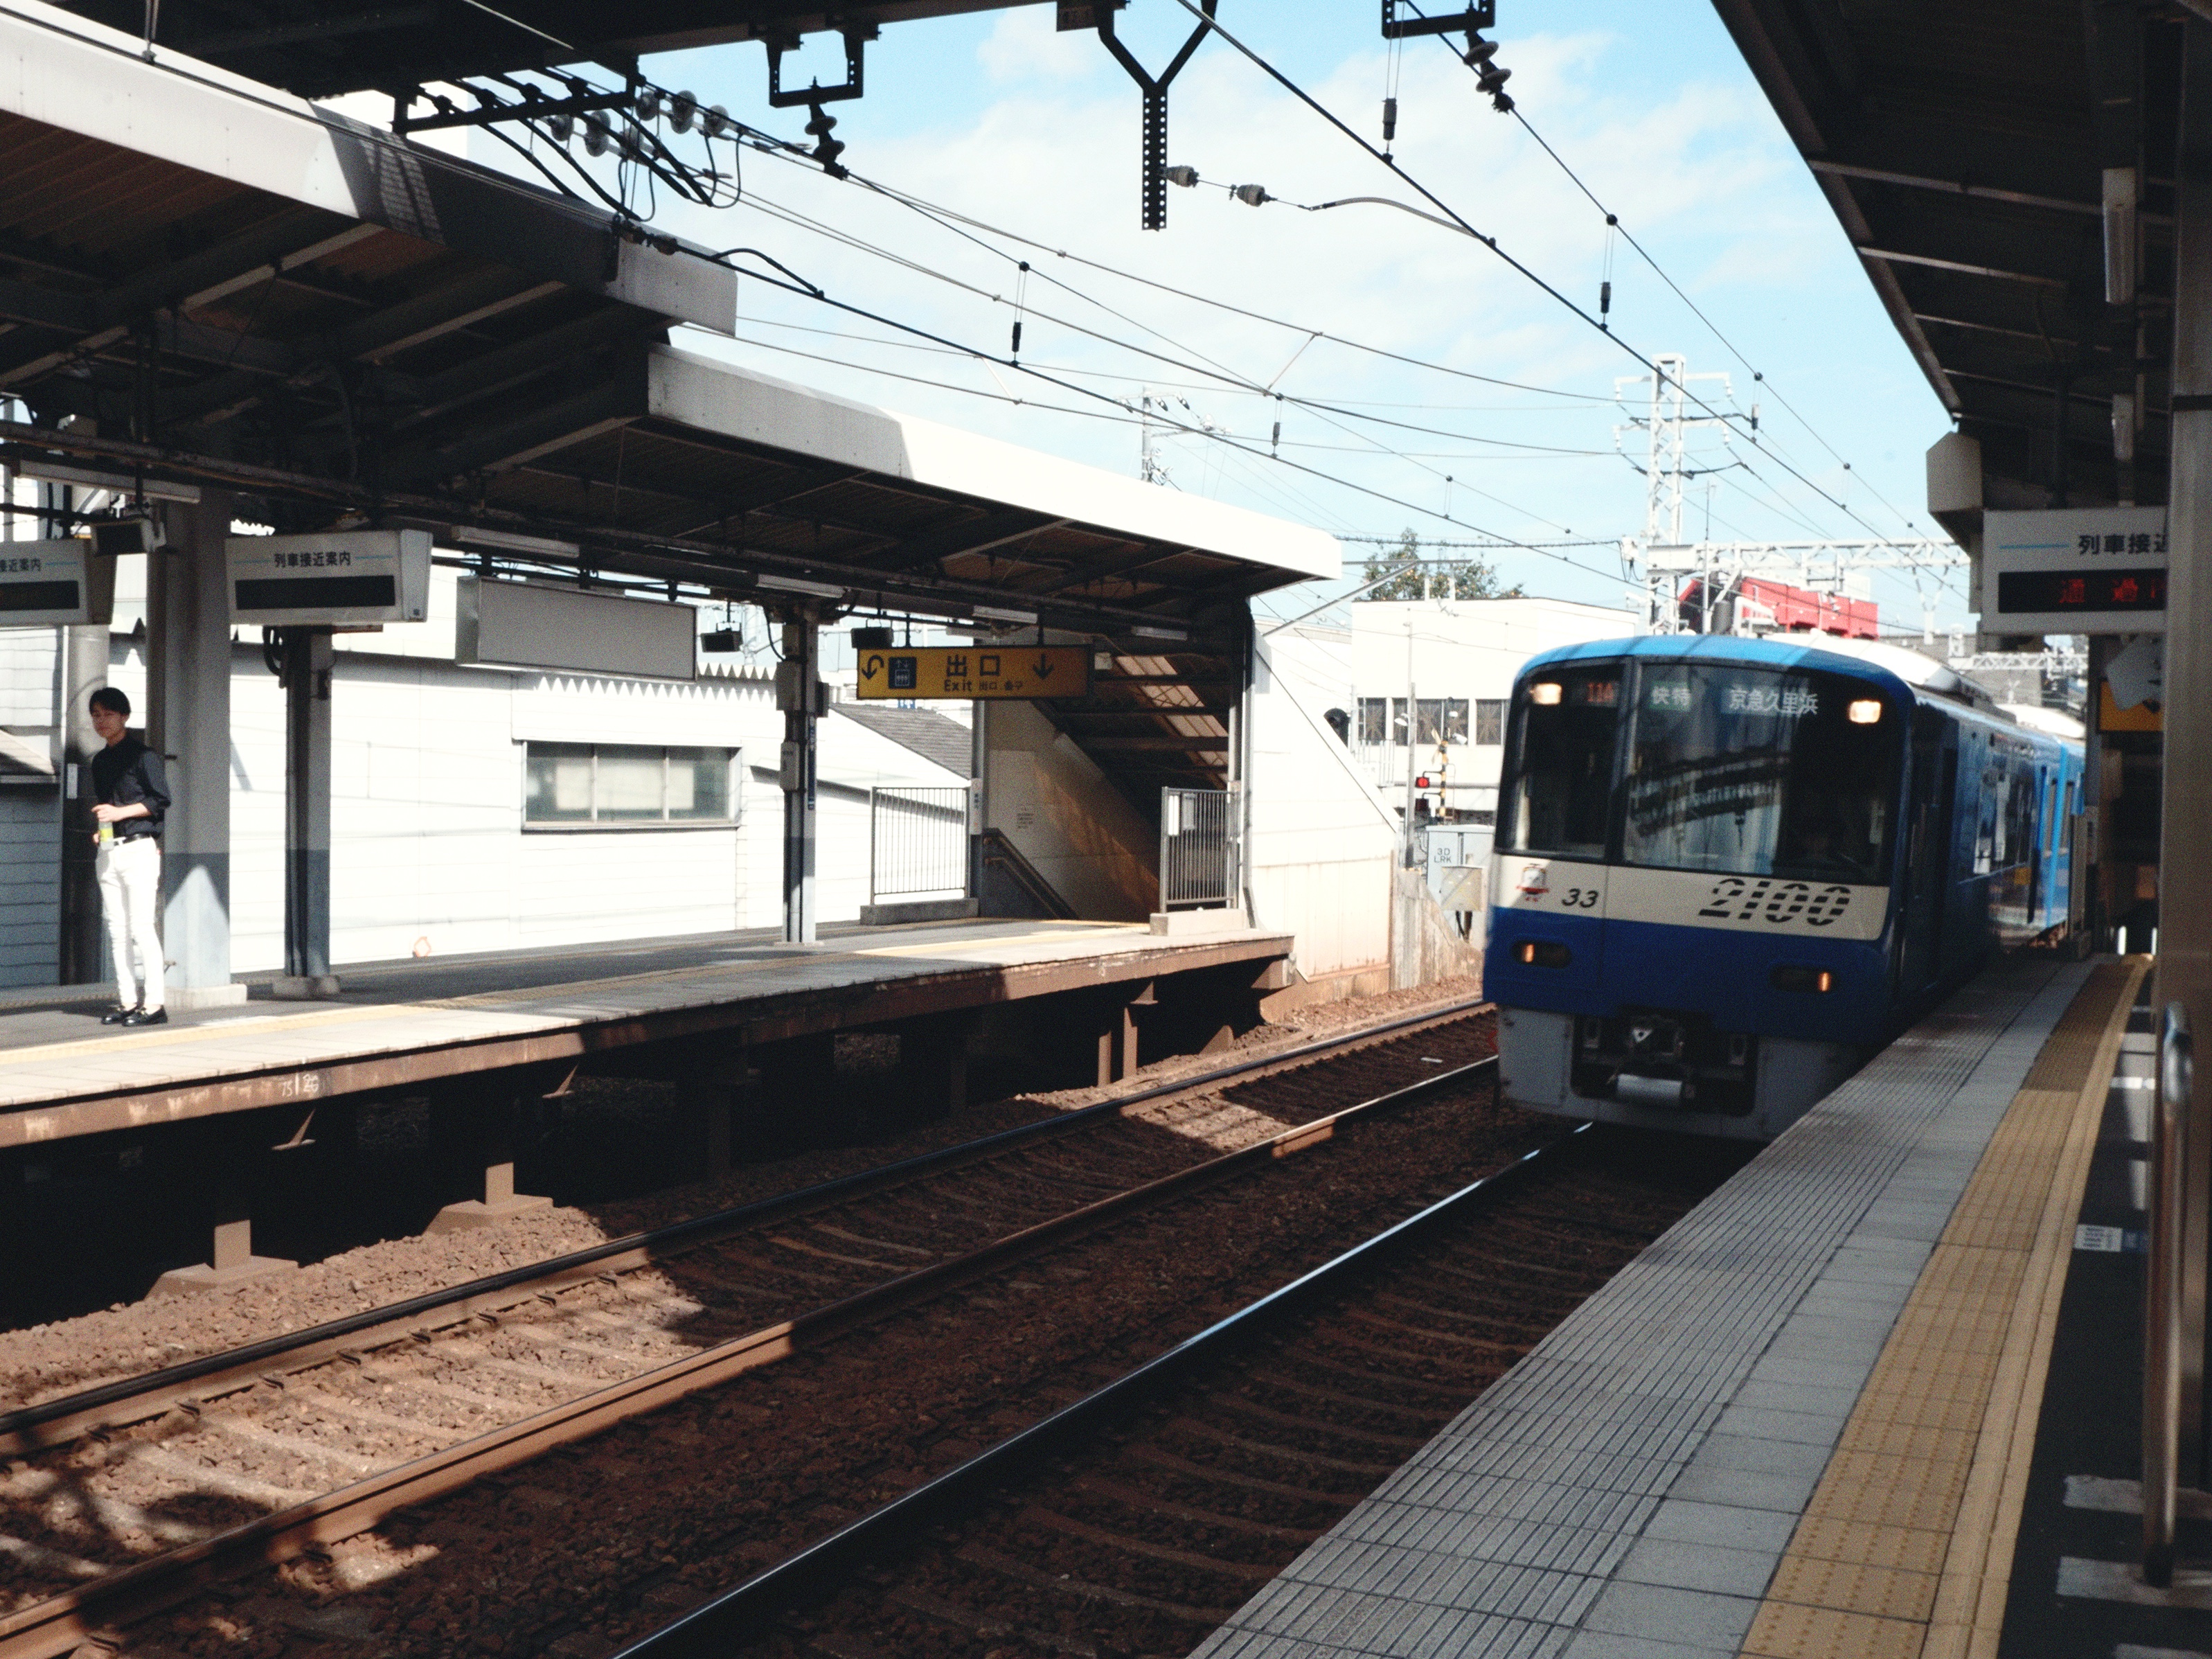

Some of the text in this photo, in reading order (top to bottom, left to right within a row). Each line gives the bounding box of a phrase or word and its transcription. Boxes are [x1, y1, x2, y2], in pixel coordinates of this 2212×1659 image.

[274, 551, 351, 568] 列車接近案内
[946, 654, 1001, 677] 出口
[944, 679, 972, 692] Exit
[1651, 686, 1691, 707] 快特
[1729, 688, 1819, 716] 京急久里浜
[1561, 888, 1599, 908] 33
[1697, 878, 1851, 926] 2100
